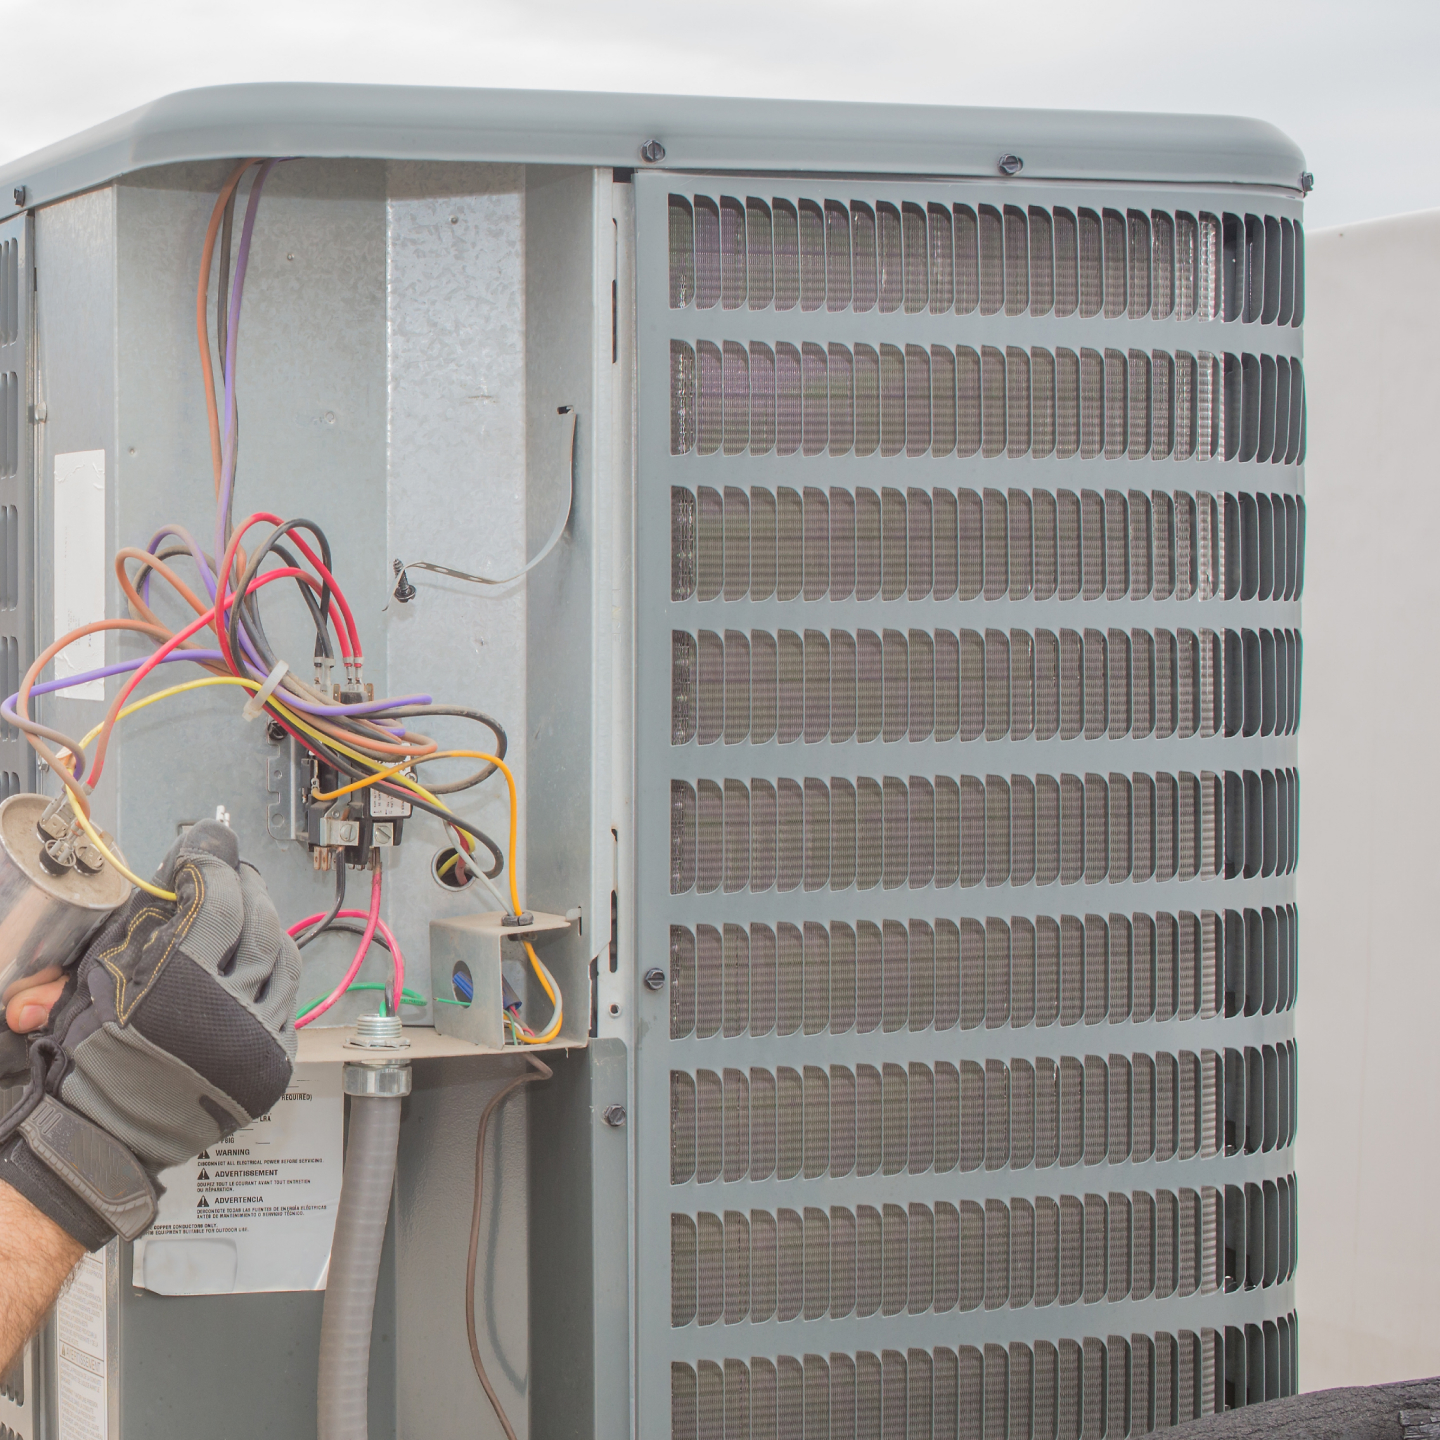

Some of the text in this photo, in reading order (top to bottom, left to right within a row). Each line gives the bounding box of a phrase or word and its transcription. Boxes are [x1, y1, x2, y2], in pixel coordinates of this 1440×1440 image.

[216, 1148, 250, 1156] WARNING
[215, 1169, 278, 1178] ADVERTISSEMENT
[214, 1196, 264, 1204] ADVERTENCIA
